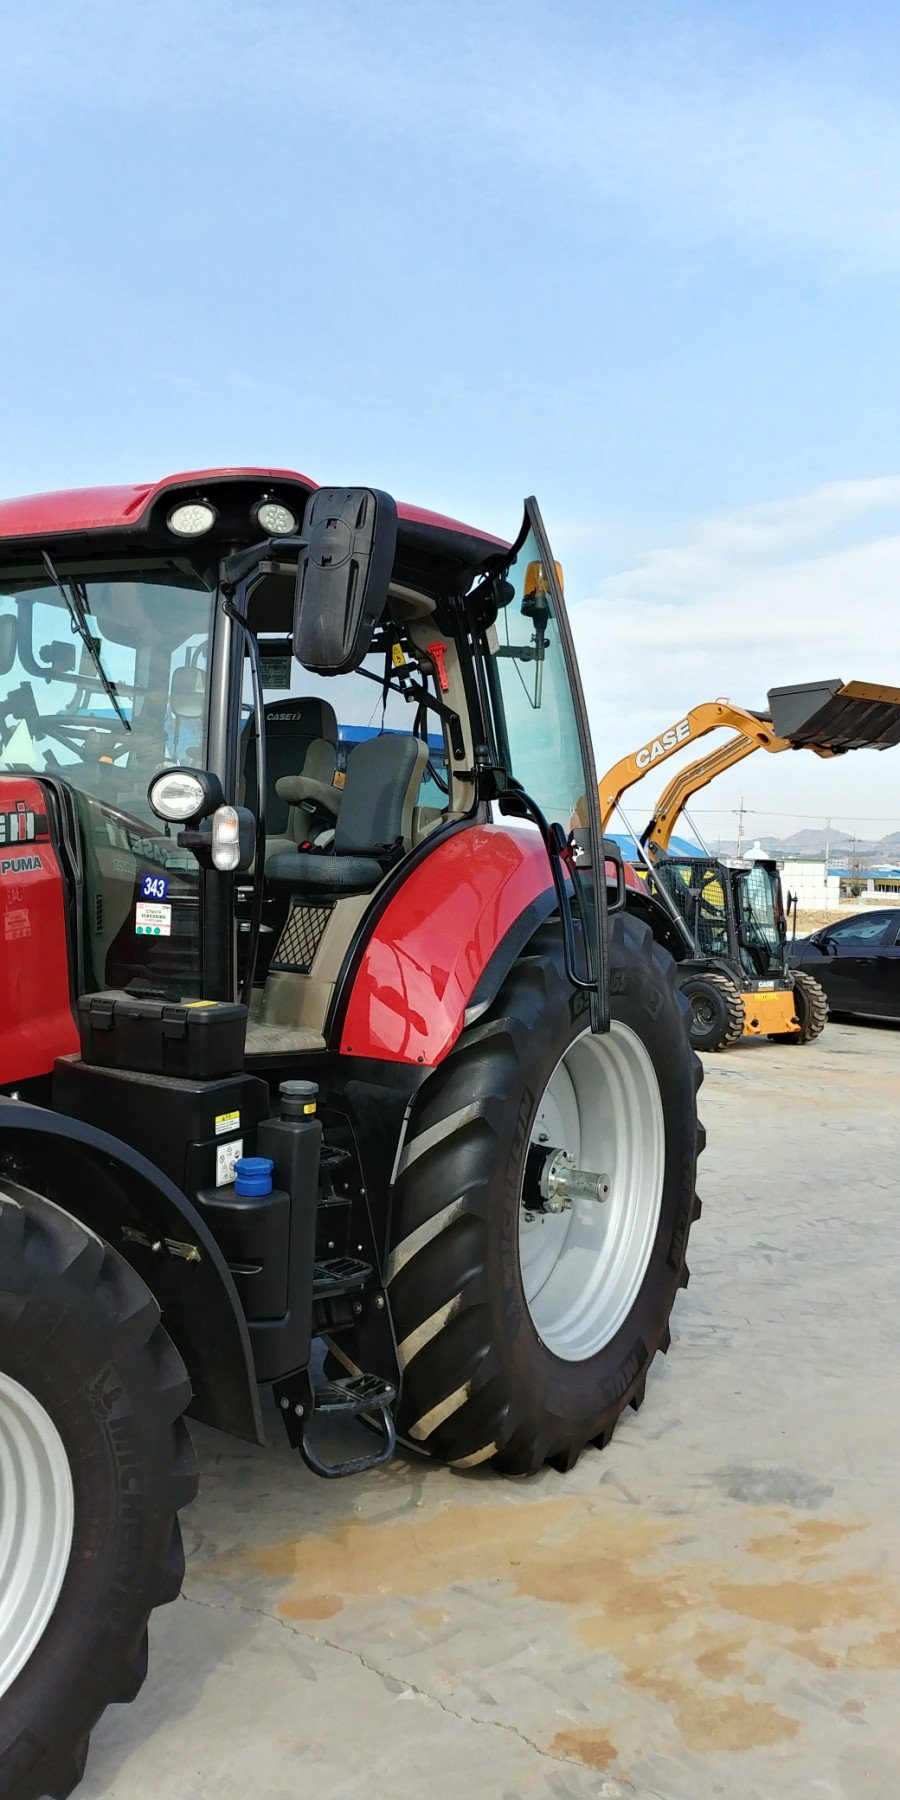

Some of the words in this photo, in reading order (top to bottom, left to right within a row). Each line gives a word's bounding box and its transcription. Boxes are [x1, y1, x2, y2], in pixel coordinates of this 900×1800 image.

[266, 712, 292, 721] CASE
[635, 717, 691, 769] CASE
[1, 855, 43, 874] PUMA
[143, 877, 165, 898] 343
[757, 980, 775, 988] CASE
